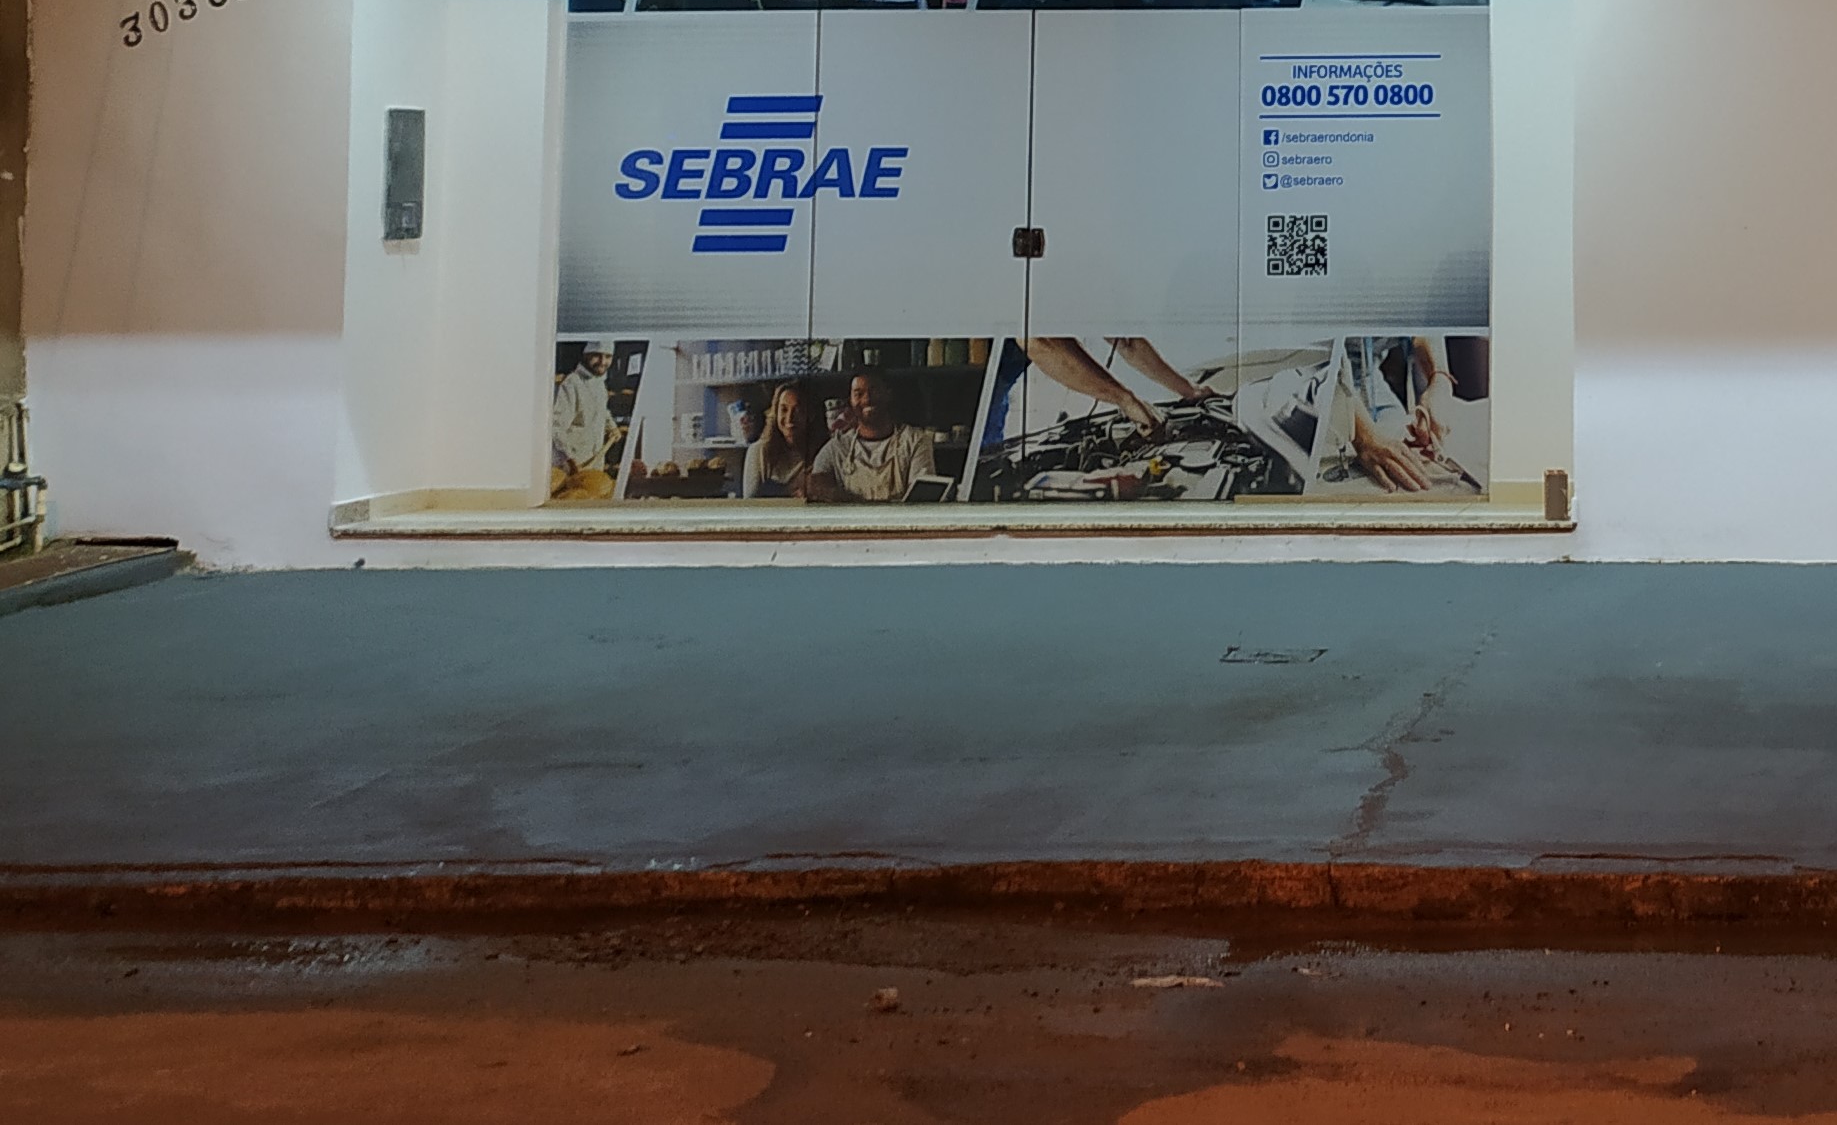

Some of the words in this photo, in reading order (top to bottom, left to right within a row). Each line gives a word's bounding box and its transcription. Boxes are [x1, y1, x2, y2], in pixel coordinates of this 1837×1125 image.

[1292, 61, 1403, 82] INFORMAÇÕES
[1261, 84, 1321, 106] 0800
[1326, 84, 1369, 106] 570
[1374, 83, 1434, 105] 0800
[1281, 131, 1374, 144] /sebraerondonia
[1281, 153, 1333, 166] sebraero
[614, 147, 909, 200] SEBRAE
[1279, 174, 1344, 188] @sebraero
